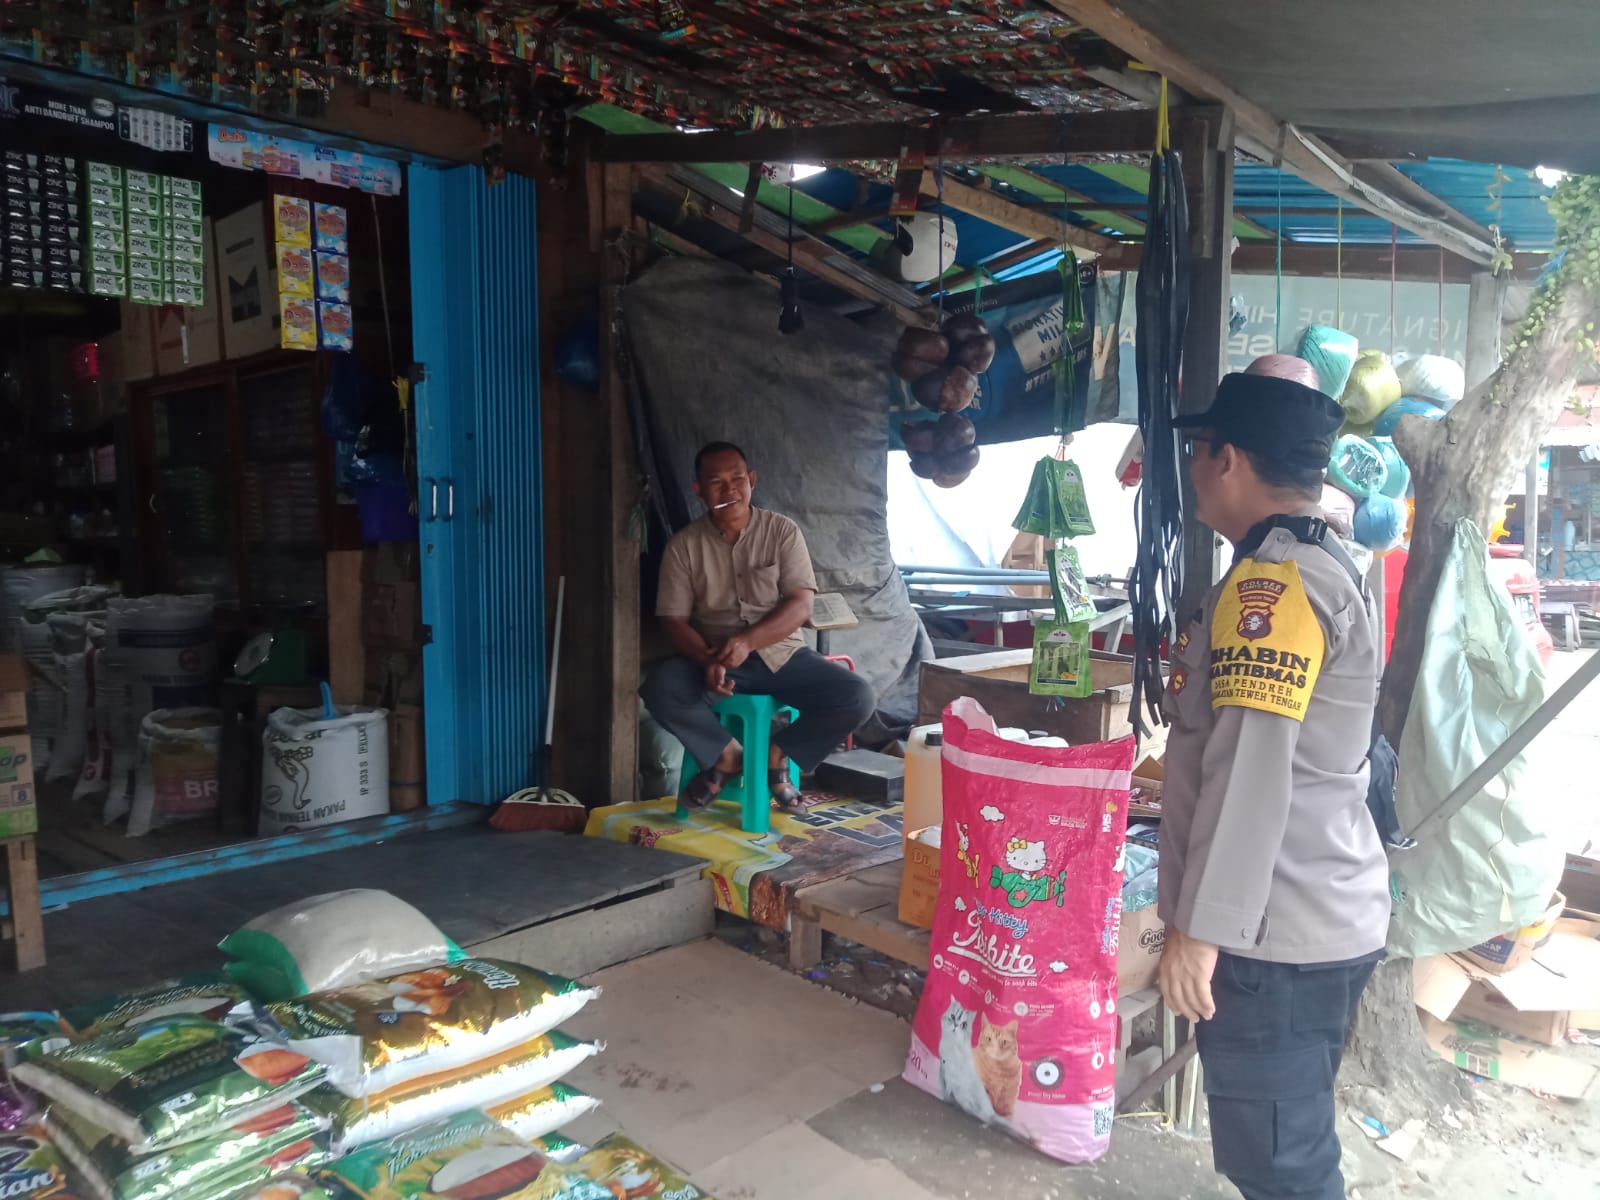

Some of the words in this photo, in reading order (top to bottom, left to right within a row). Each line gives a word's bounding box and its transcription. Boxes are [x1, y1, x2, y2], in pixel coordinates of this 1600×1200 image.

[48, 100, 67, 113] MORE
[69, 104, 87, 116] THAN
[80, 116, 115, 131] SHAMPOO
[1037, 325, 1063, 343] MIL
[1234, 679, 1293, 696] PENDREH
[1236, 689, 1267, 702] TEWEH
[313, 800, 346, 819] PAKAN
[989, 907, 1029, 939] Kitty
[0, 1171, 54, 1199] ian
